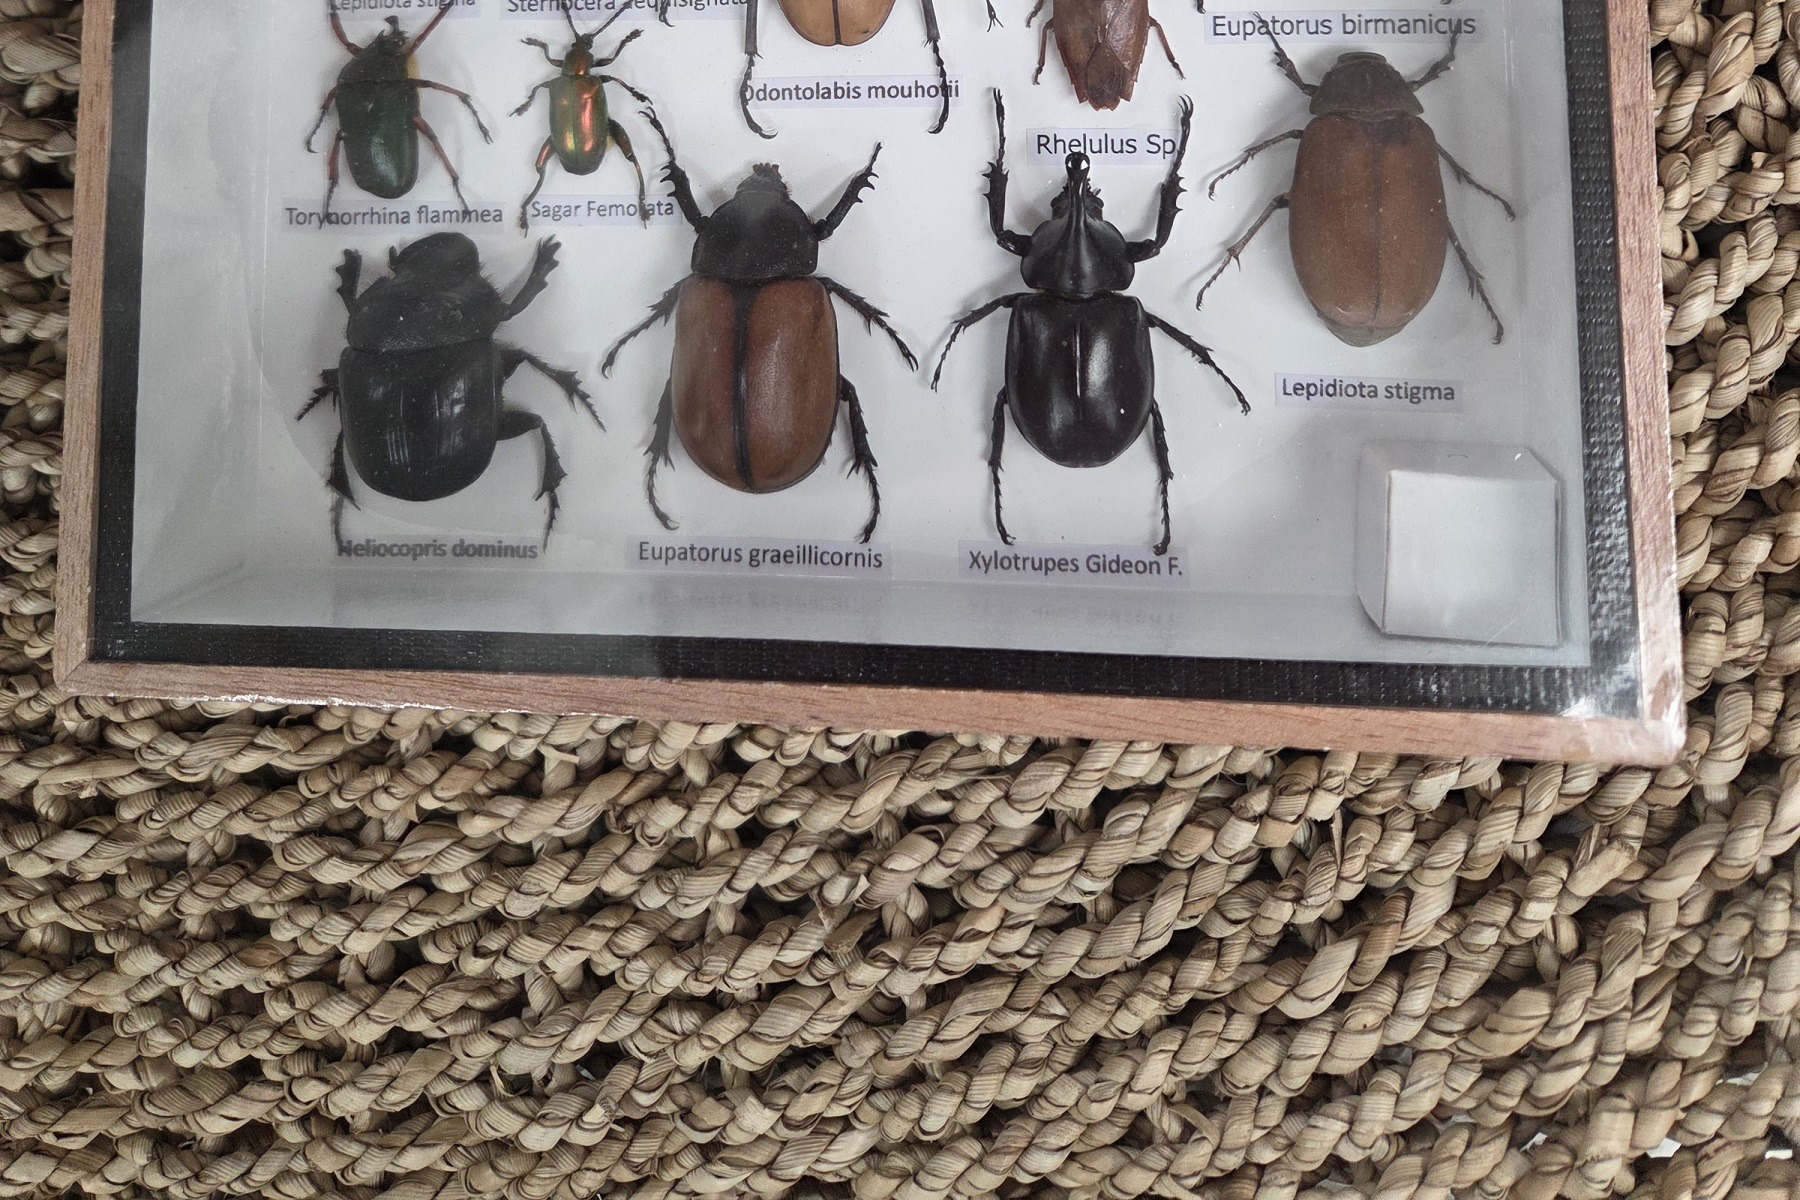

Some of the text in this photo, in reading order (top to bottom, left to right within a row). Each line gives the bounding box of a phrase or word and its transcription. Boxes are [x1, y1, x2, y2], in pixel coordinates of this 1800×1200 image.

[1212, 13, 1477, 41] Eupatorus birmanicus
[867, 80, 960, 99] mouhoii
[1037, 133, 1138, 155] Rhelulus
[416, 204, 503, 224] flammea
[531, 200, 675, 222] Sagar Femoata
[1282, 378, 1455, 404] Lepidiota stigma
[452, 538, 538, 559] dominus
[638, 541, 884, 568] Eupatorus graeillicornis
[968, 550, 1183, 576] Xylotrupes Gideon F.
